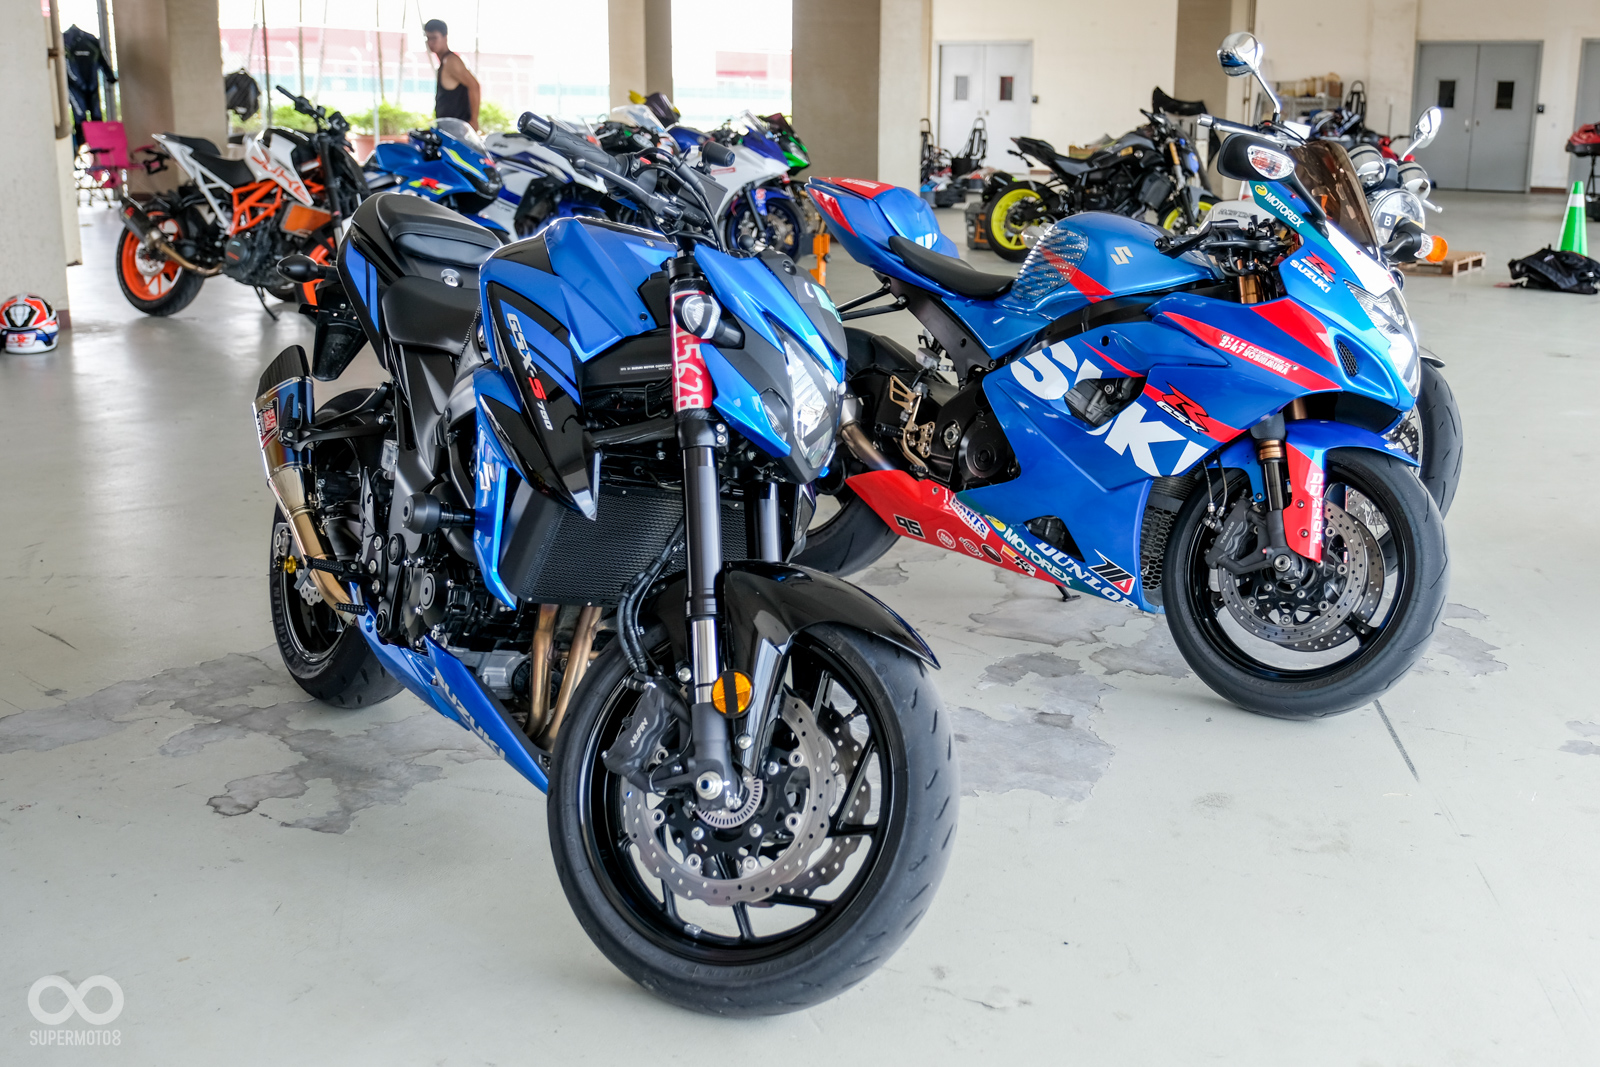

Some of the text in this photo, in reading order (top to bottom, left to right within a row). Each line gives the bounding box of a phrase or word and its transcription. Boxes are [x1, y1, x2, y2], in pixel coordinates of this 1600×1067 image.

[1265, 192, 1305, 228] MOTOREX
[1384, 215, 1392, 226] B
[1289, 259, 1332, 293] SUZUKI
[1156, 401, 1205, 434] GSX
[1309, 472, 1324, 545] DUNLOP
[895, 515, 925, 538] 95
[1003, 527, 1073, 586] MOTOREX
[273, 586, 295, 659] MICHELIN
